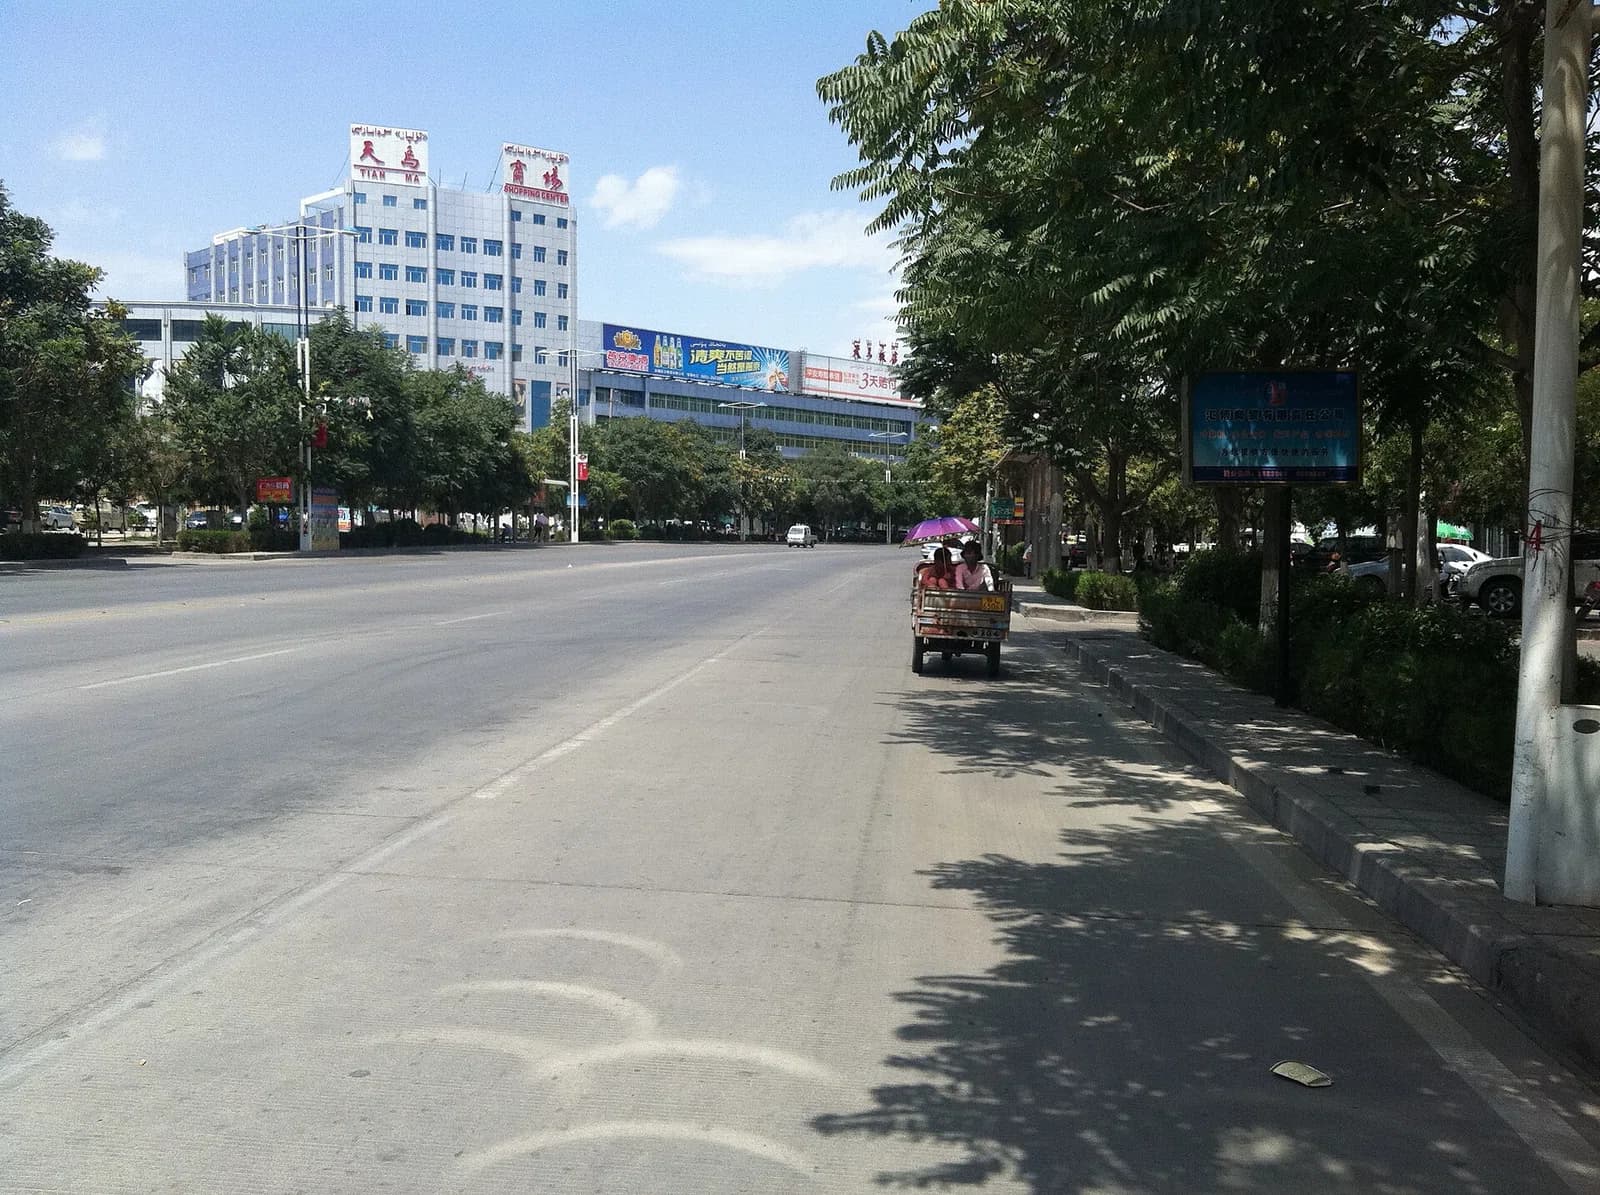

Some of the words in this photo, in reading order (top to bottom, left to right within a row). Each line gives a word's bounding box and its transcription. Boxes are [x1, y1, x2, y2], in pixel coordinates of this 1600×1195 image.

[360, 168, 386, 181] TIAN
[405, 173, 421, 185] MA
[503, 184, 541, 199] SHOPPING
[541, 191, 570, 204] CENTER
